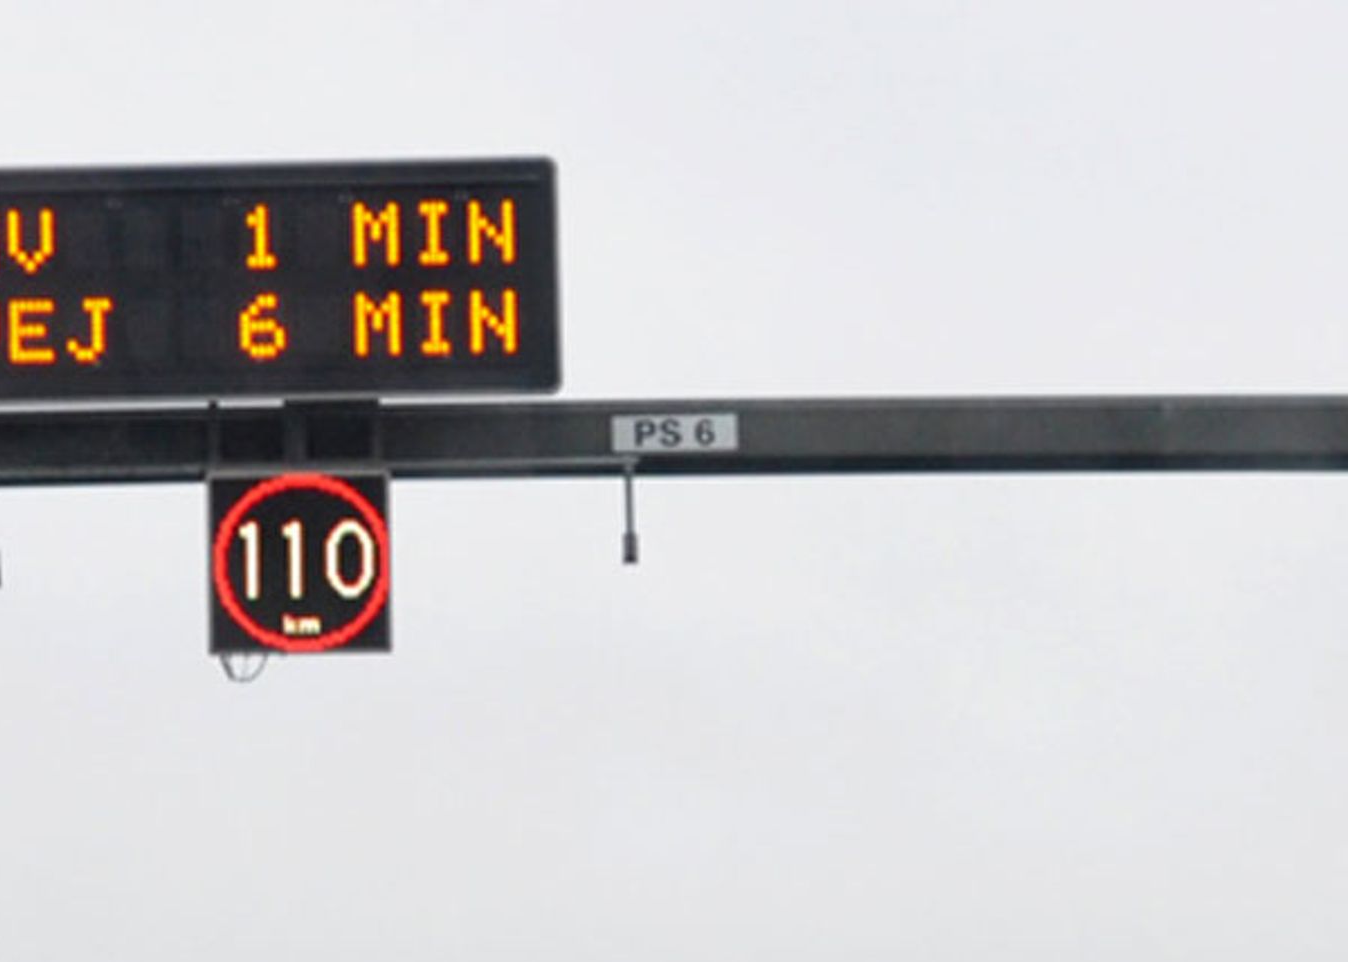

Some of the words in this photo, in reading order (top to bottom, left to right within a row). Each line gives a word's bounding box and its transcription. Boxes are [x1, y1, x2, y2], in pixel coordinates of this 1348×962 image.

[245, 203, 279, 271] 1
[350, 198, 517, 269] MIN
[237, 291, 289, 361] 6
[352, 287, 519, 358] MIN
[634, 418, 683, 447] PS
[694, 417, 716, 446] 6
[238, 518, 374, 600] 110
[283, 613, 322, 635] km
